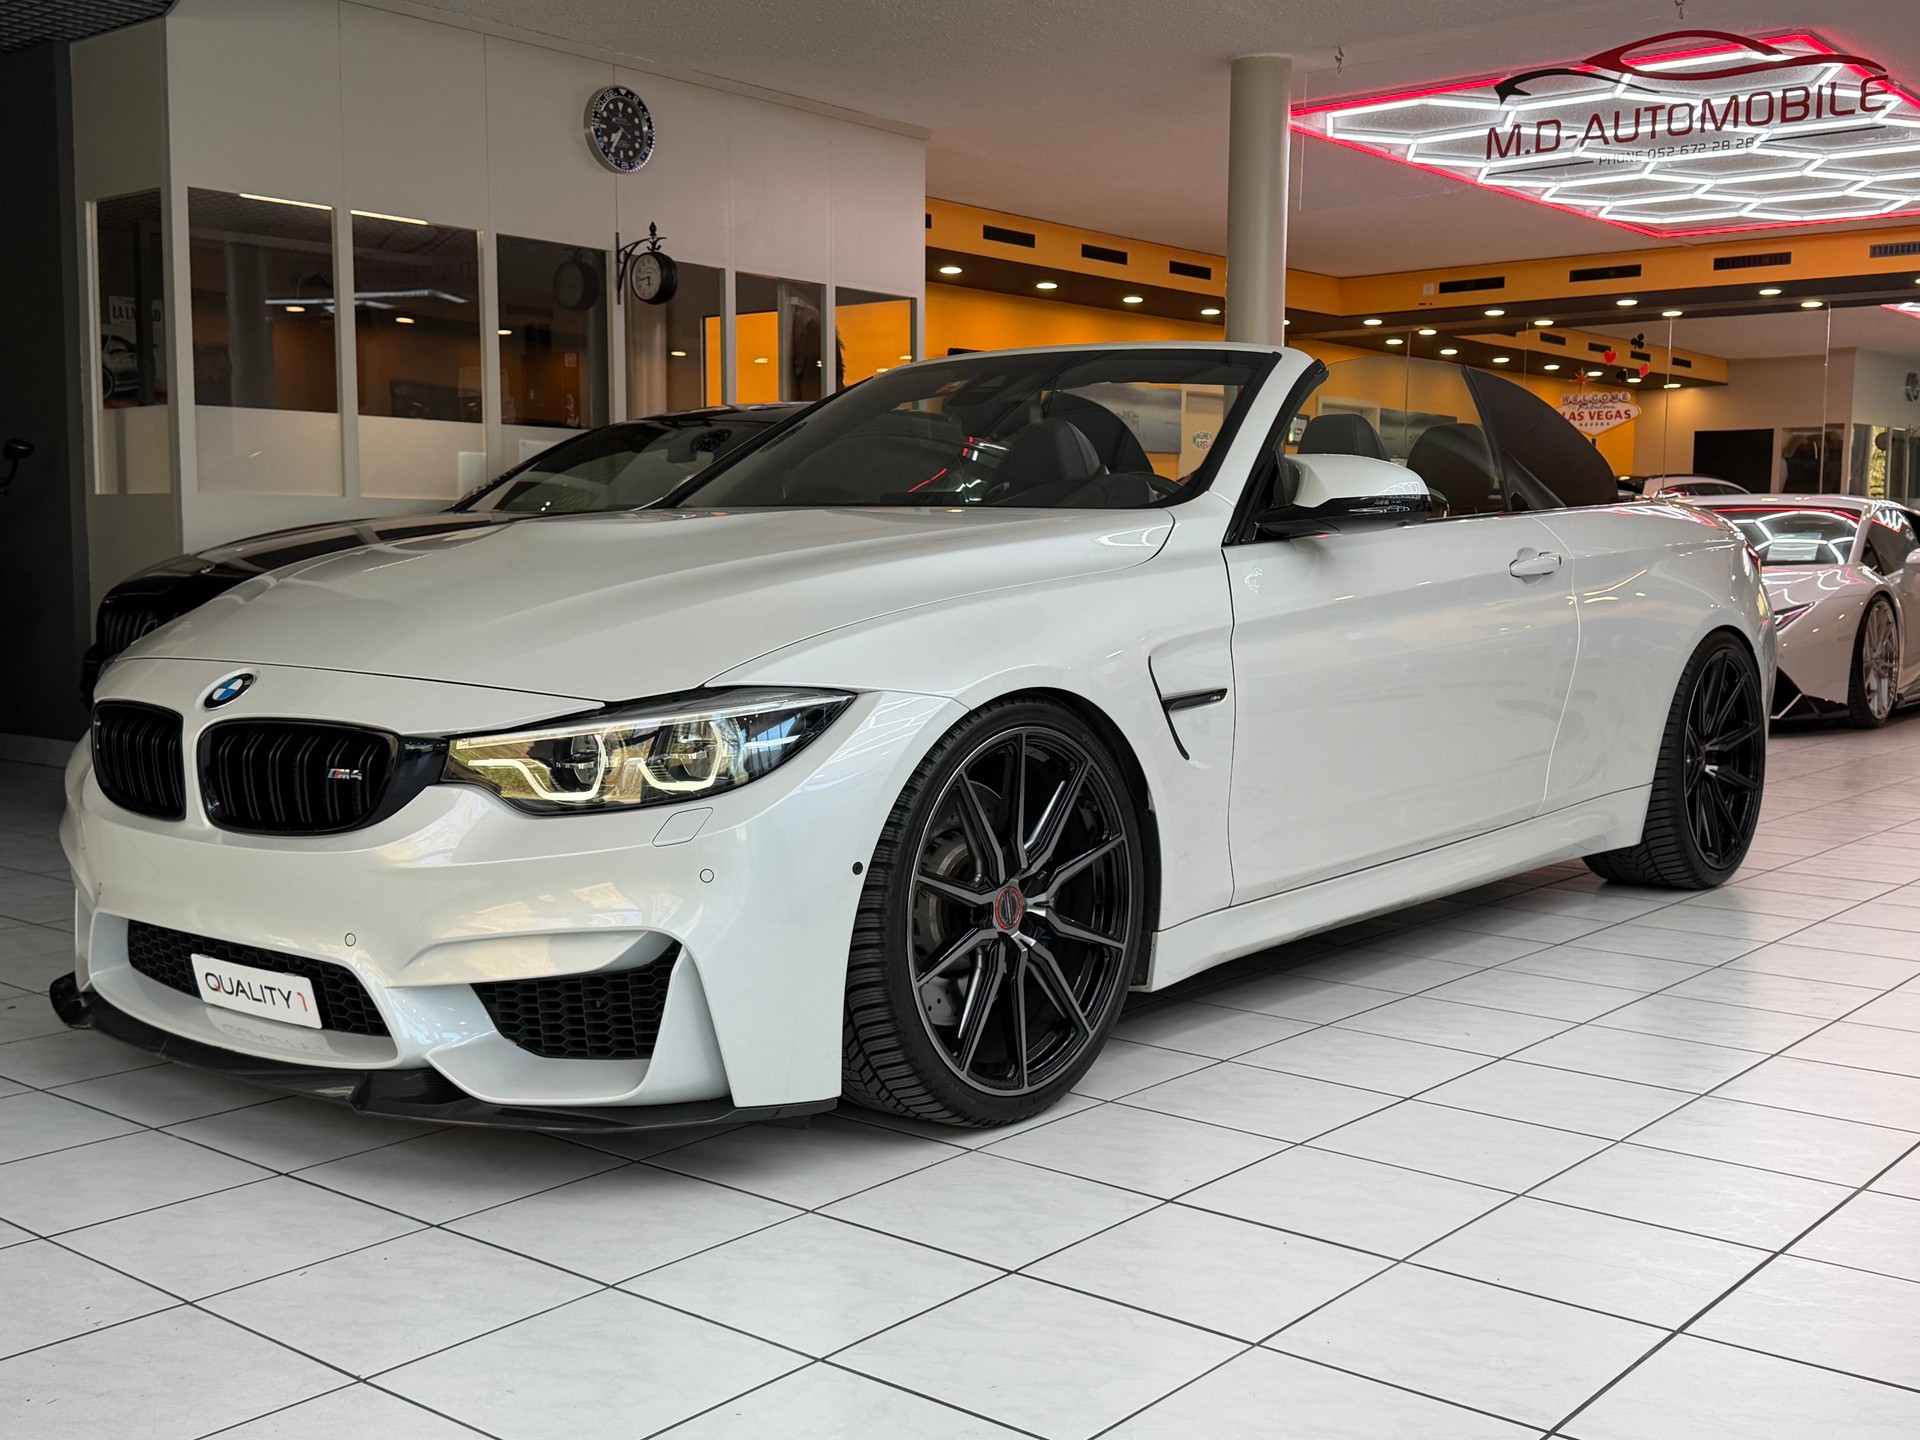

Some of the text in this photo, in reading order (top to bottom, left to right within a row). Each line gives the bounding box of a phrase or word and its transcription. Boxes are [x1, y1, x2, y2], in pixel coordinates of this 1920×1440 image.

[1486, 74, 1889, 160] M.D-AUTOMOBILE
[1598, 137, 1755, 166] PHONE 052 672 28 28
[1561, 392, 1629, 403] WELCOME
[1588, 409, 1632, 421] VEGAS
